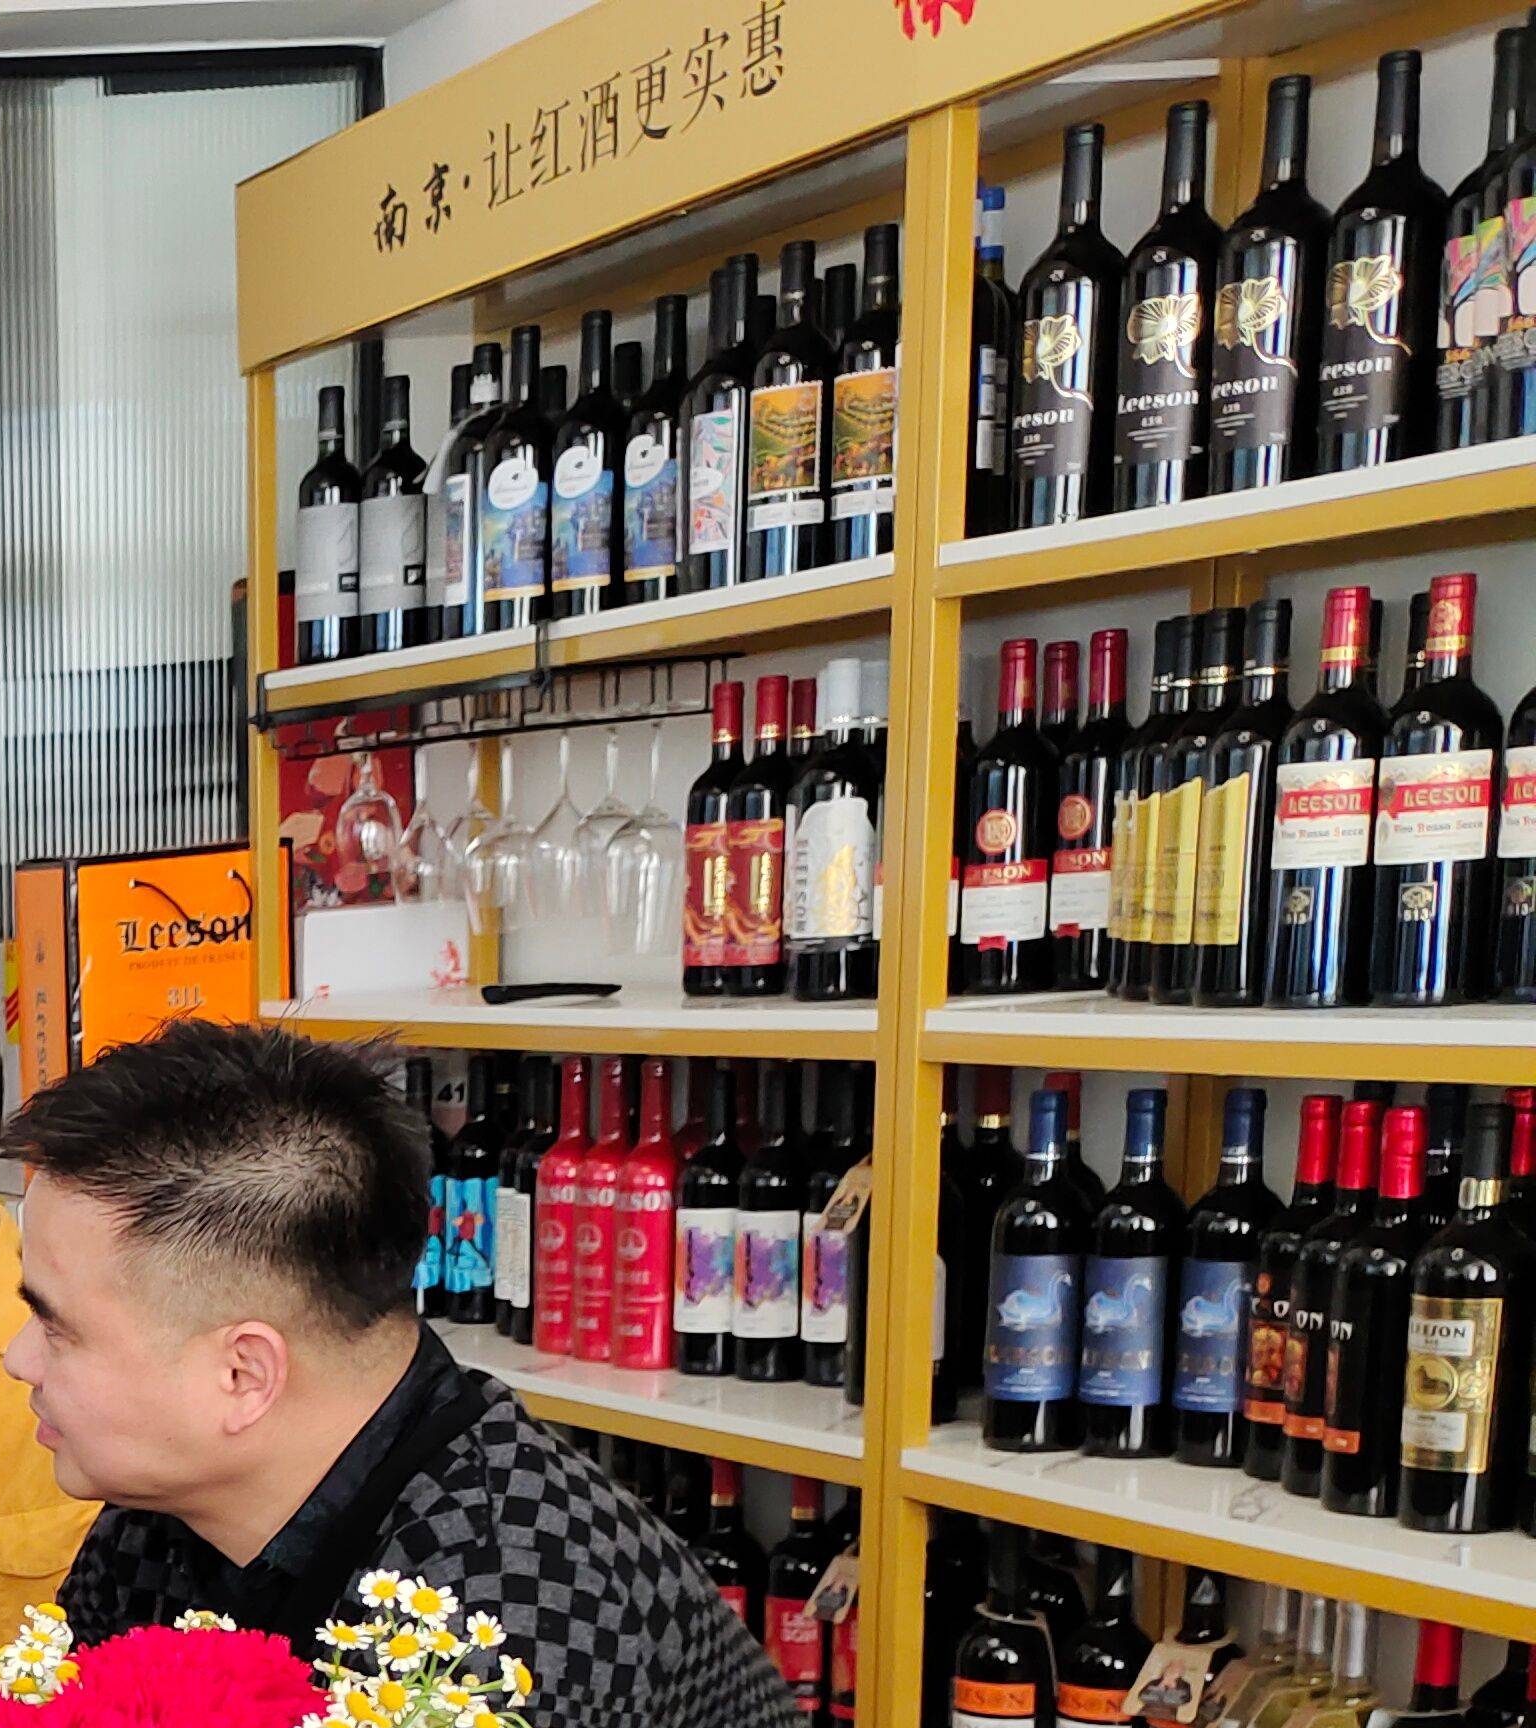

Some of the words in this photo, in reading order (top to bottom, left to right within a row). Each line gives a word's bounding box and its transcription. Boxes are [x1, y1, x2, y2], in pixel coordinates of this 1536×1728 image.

[1319, 356, 1394, 381] eeson
[1211, 374, 1279, 401] eeson
[1013, 407, 1075, 430] eeson
[1288, 793, 1362, 815] LEESON
[1402, 785, 1482, 809] LEESON
[116, 912, 252, 957] Leeson
